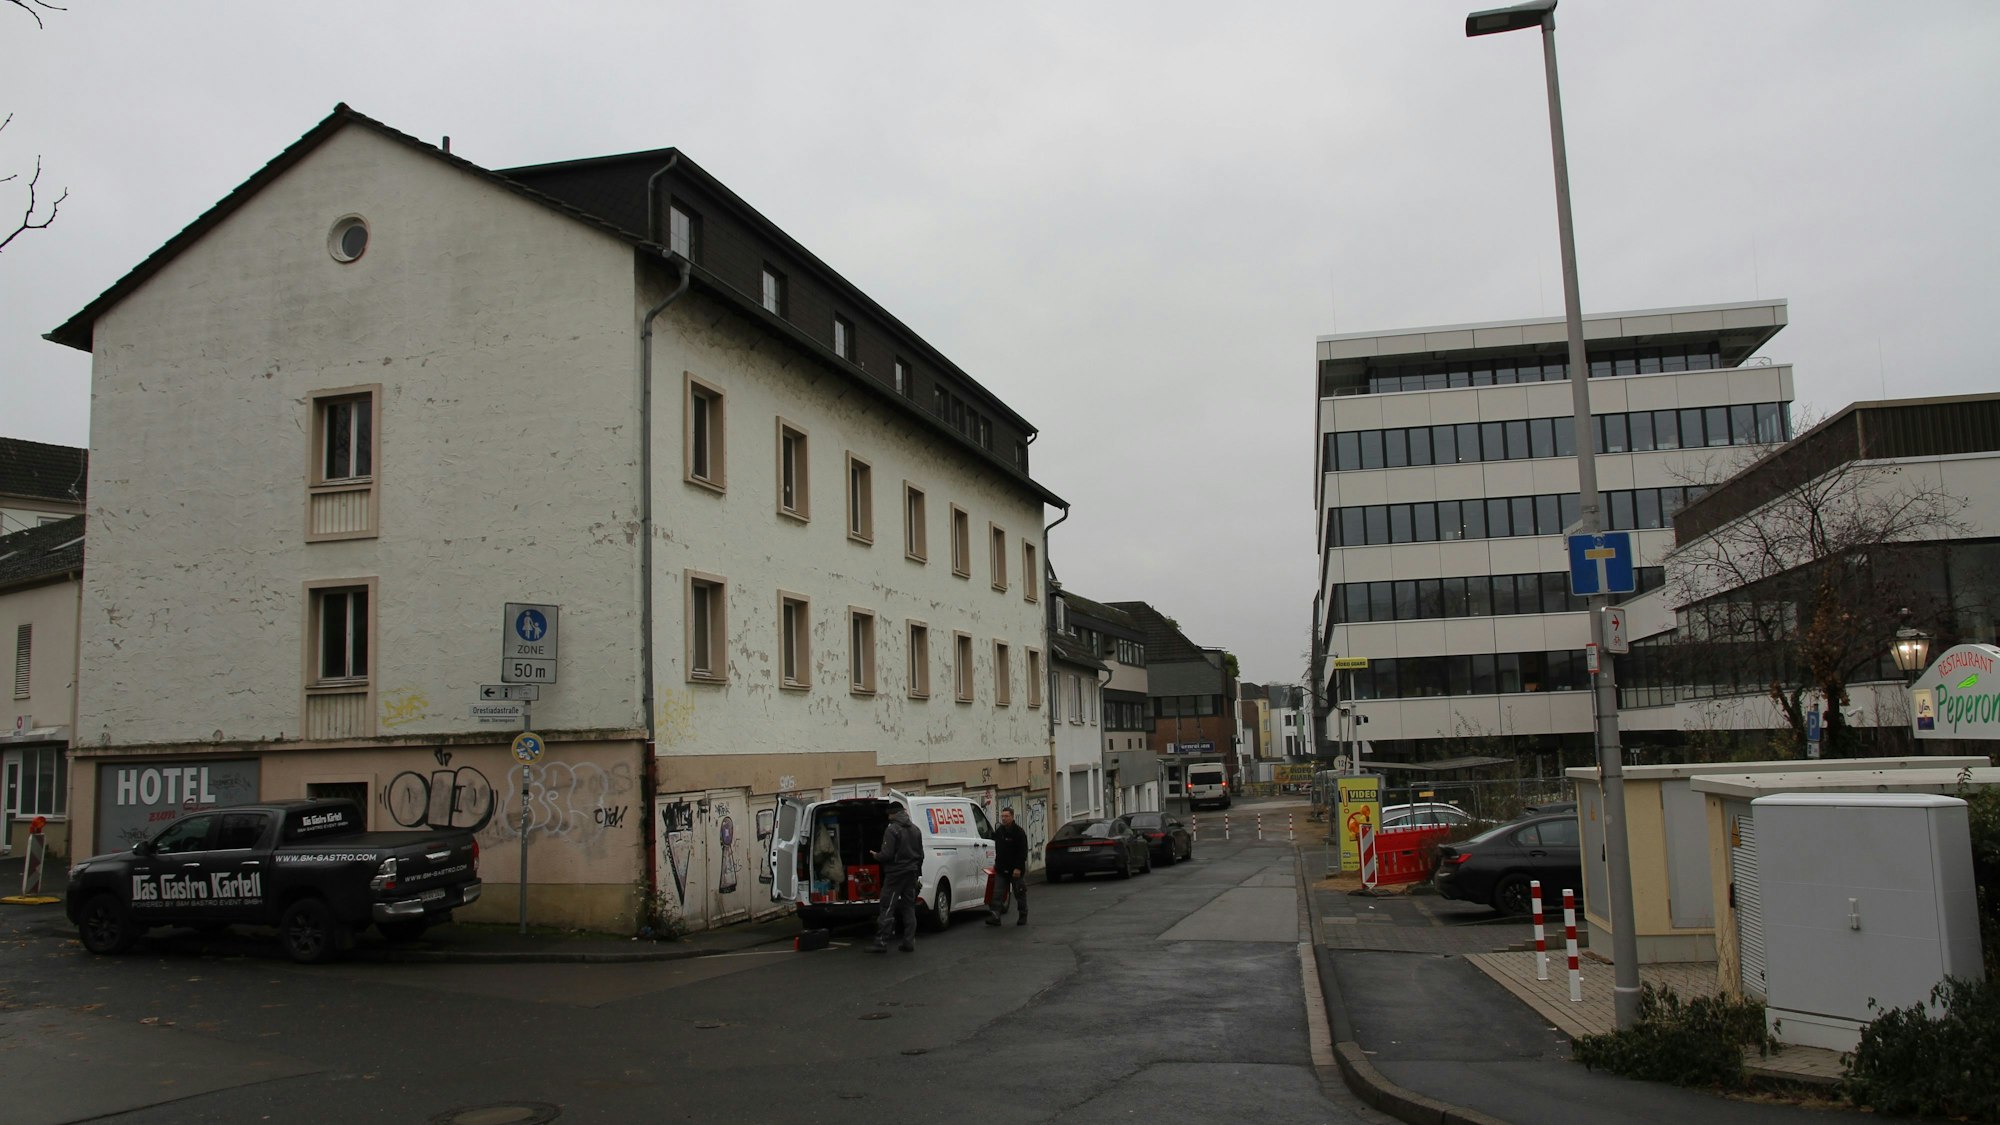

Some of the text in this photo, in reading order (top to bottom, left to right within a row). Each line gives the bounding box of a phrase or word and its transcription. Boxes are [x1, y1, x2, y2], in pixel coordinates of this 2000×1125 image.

[517, 644, 545, 655] ZONE
[515, 663, 546, 678] 50 m
[1938, 651, 1994, 678] RESTAURANT
[472, 706, 519, 714] Orestiadastraße
[1809, 714, 1817, 737] P
[116, 766, 217, 806] HOTEL
[1349, 790, 1377, 798] VIDEO
[936, 808, 965, 825] GLASS
[274, 853, 377, 863] WWW.GM-GASTRO.COM
[404, 863, 468, 883] WWW.GM-GASTRO.COM
[131, 871, 262, 901] Das Gastro Kartell
[131, 901, 163, 909] POWERED
